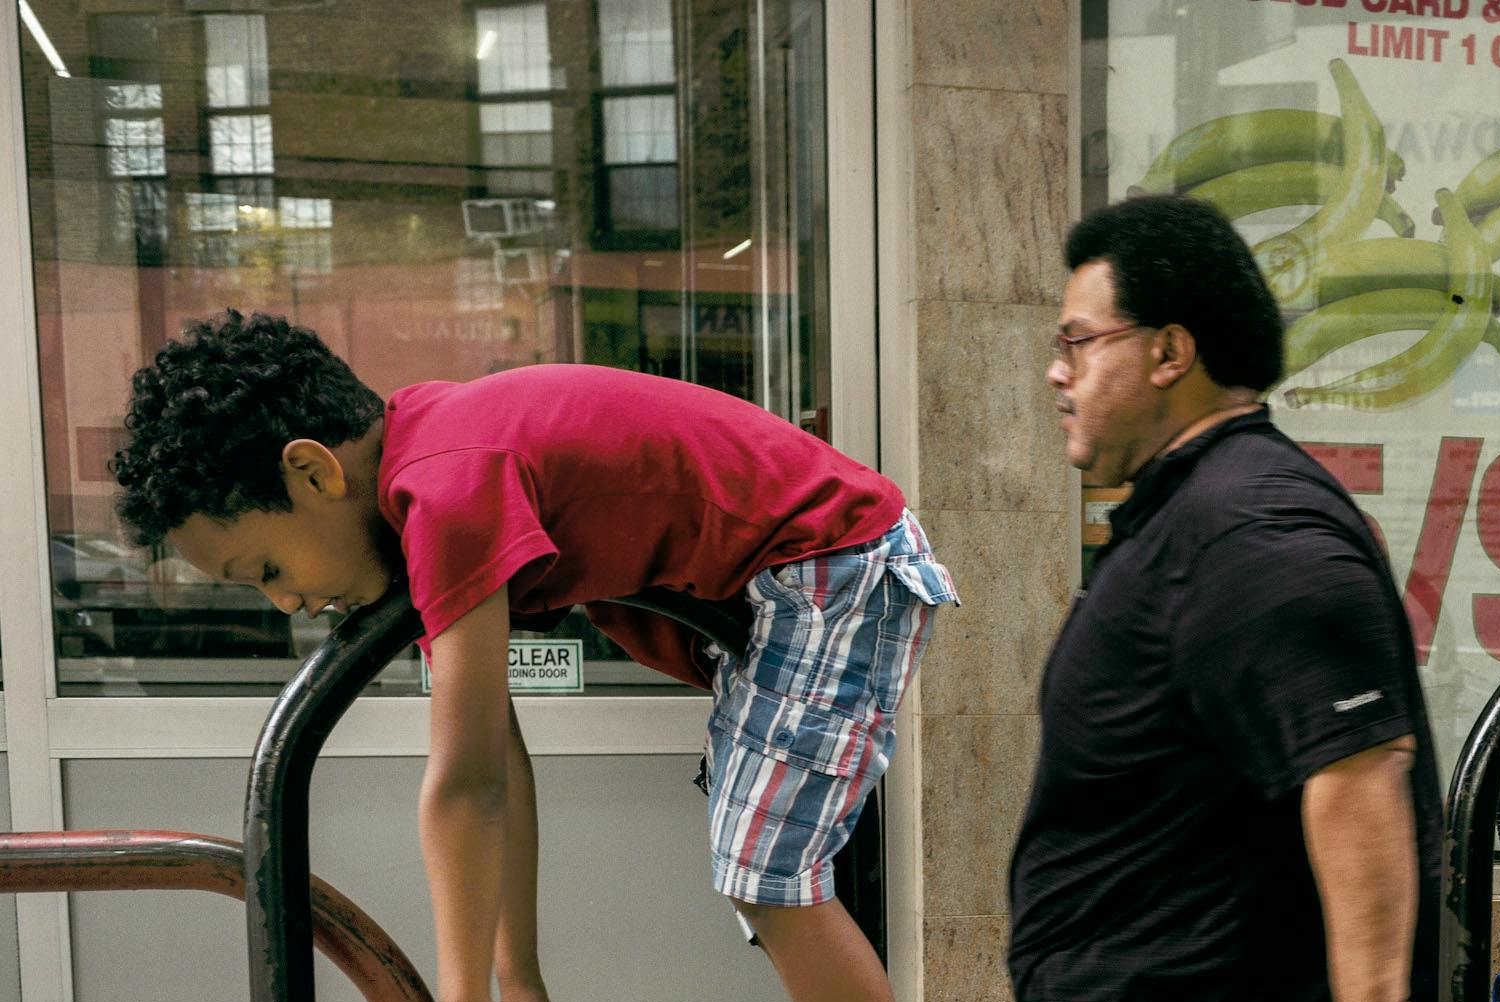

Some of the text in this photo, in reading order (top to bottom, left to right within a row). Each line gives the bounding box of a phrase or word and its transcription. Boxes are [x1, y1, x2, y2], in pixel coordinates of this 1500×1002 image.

[1347, 21, 1449, 63] LIMIT
[1461, 34, 1476, 65] 1
[508, 648, 570, 666] CLEAR
[509, 669, 567, 678] IDING DOOR
